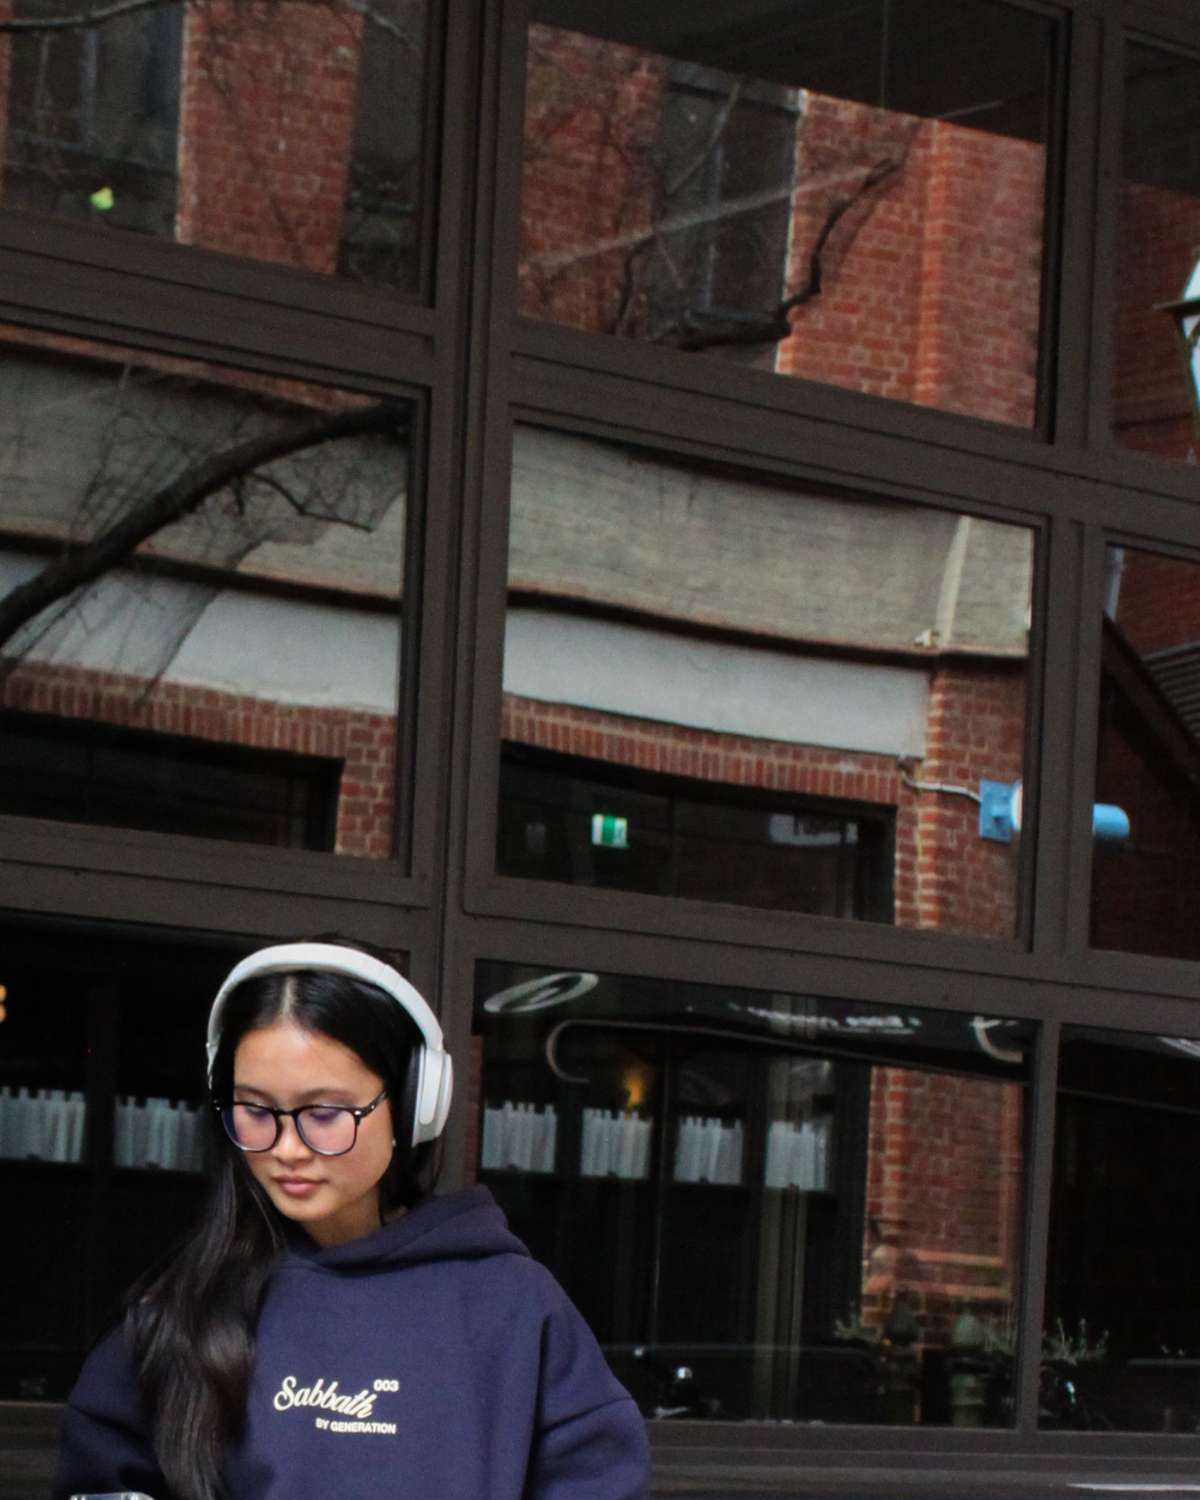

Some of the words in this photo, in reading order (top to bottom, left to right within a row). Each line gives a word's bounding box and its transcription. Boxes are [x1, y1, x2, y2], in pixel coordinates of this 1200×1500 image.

[273, 1375, 378, 1419] Sabbath
[373, 1379, 400, 1392] 003
[315, 1417, 330, 1430] BY
[330, 1421, 397, 1435] GENERATION
